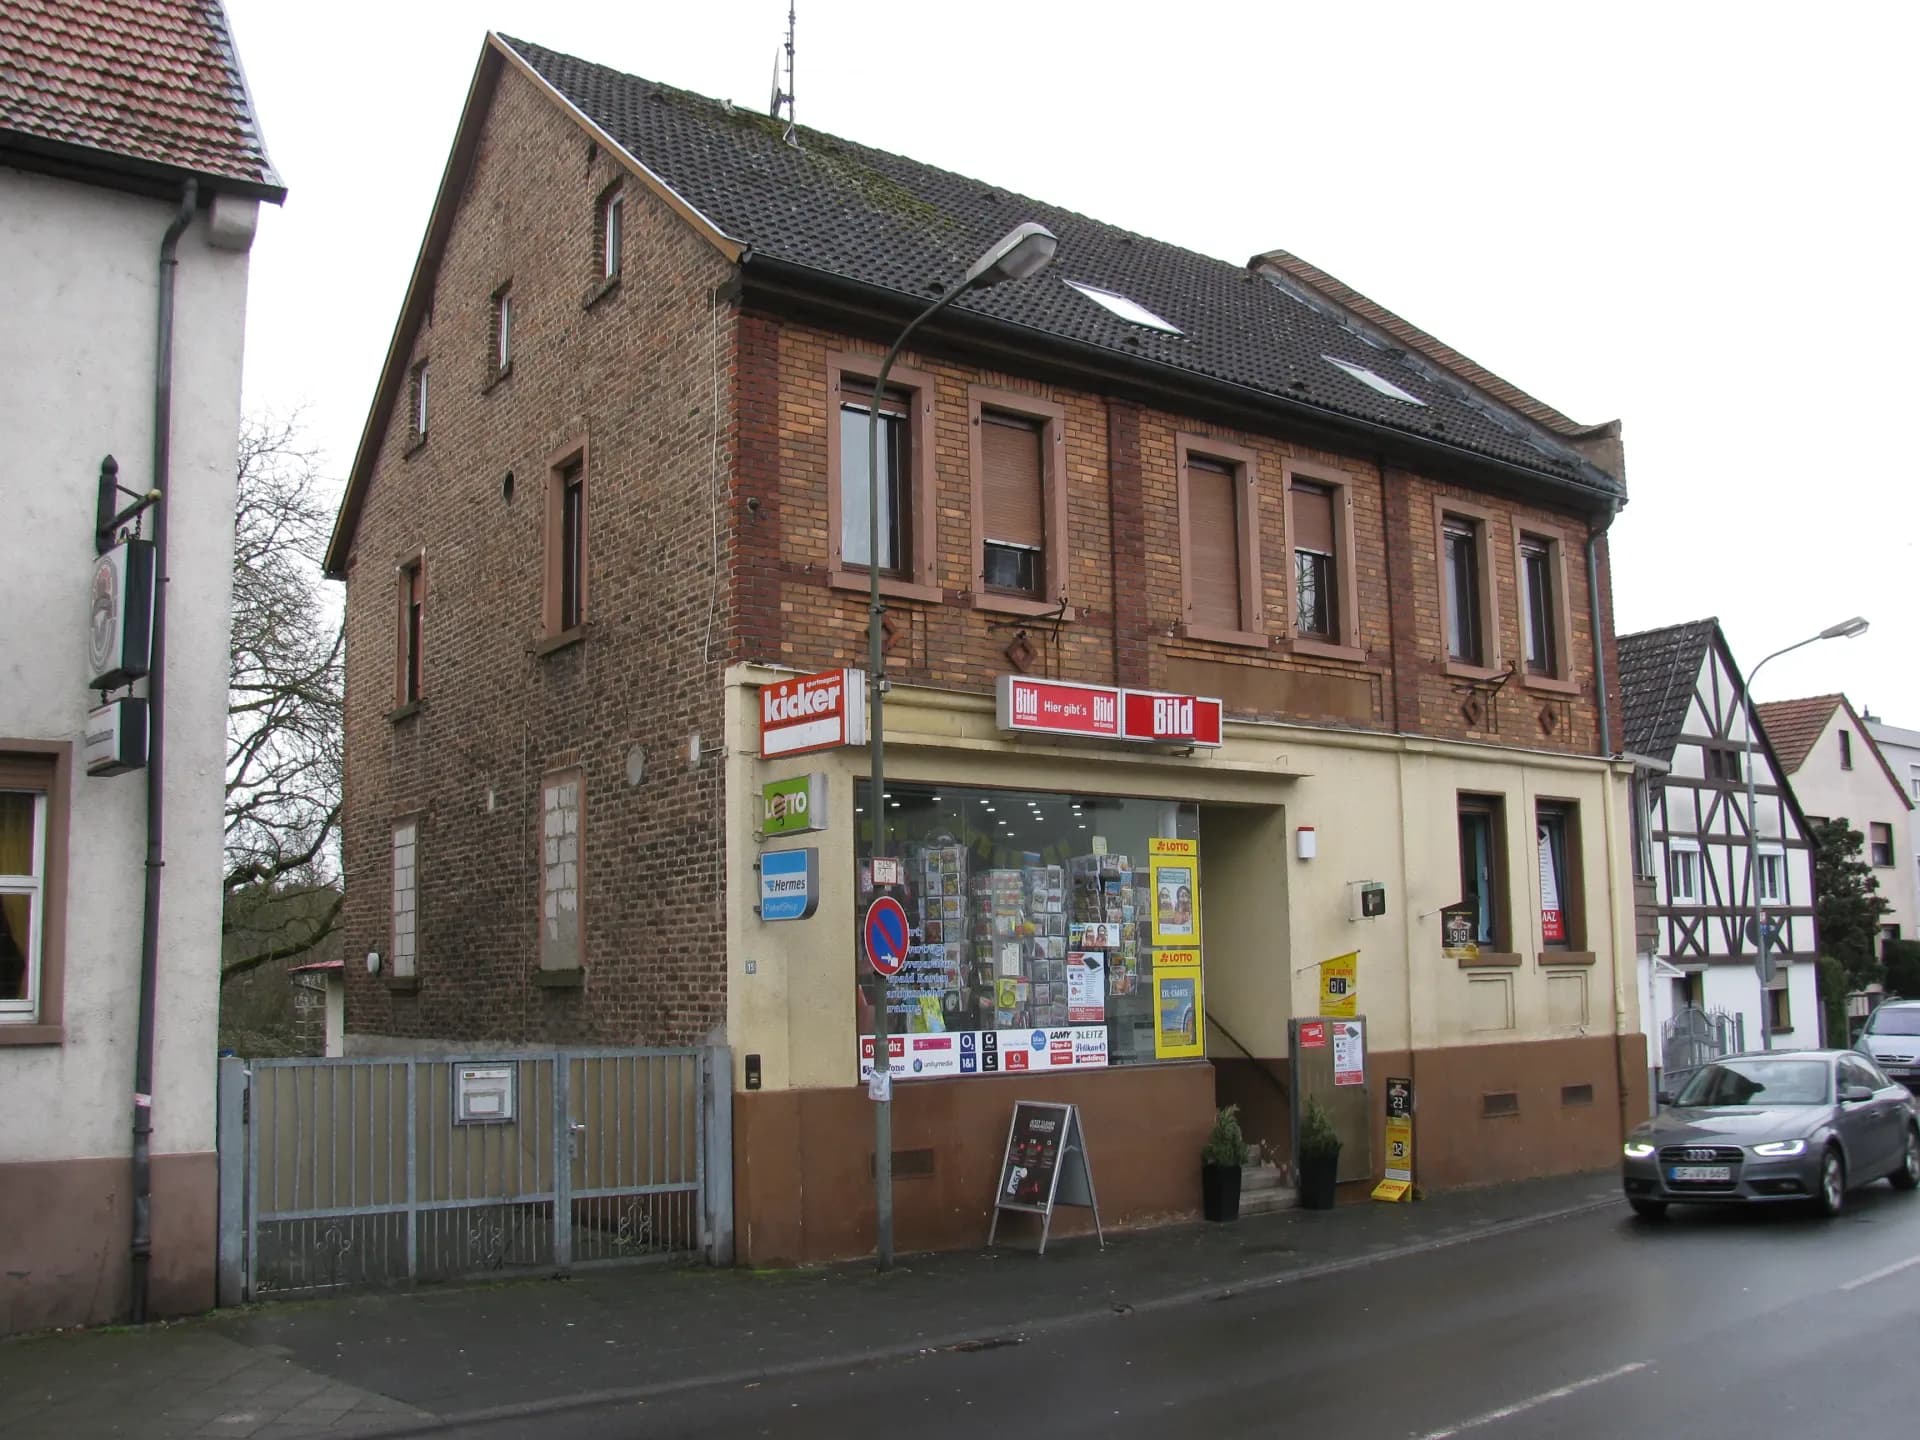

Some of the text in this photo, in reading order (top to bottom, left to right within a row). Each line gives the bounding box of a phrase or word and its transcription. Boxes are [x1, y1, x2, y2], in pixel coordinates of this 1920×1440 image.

[764, 683, 840, 722] kicker
[1015, 687, 1038, 715] Bild
[1044, 700, 1062, 713] Hier
[1093, 695, 1114, 722] Bild
[1154, 698, 1193, 735] Bild
[765, 791, 807, 819] LOTTO
[1166, 842, 1189, 852] LOTTO
[774, 879, 806, 892] Hermes
[1169, 953, 1193, 962] LOTTO
[1050, 1030, 1072, 1040] LAMY
[1082, 1030, 1104, 1039] LEITZ
[962, 1057, 974, 1069] 1&1
